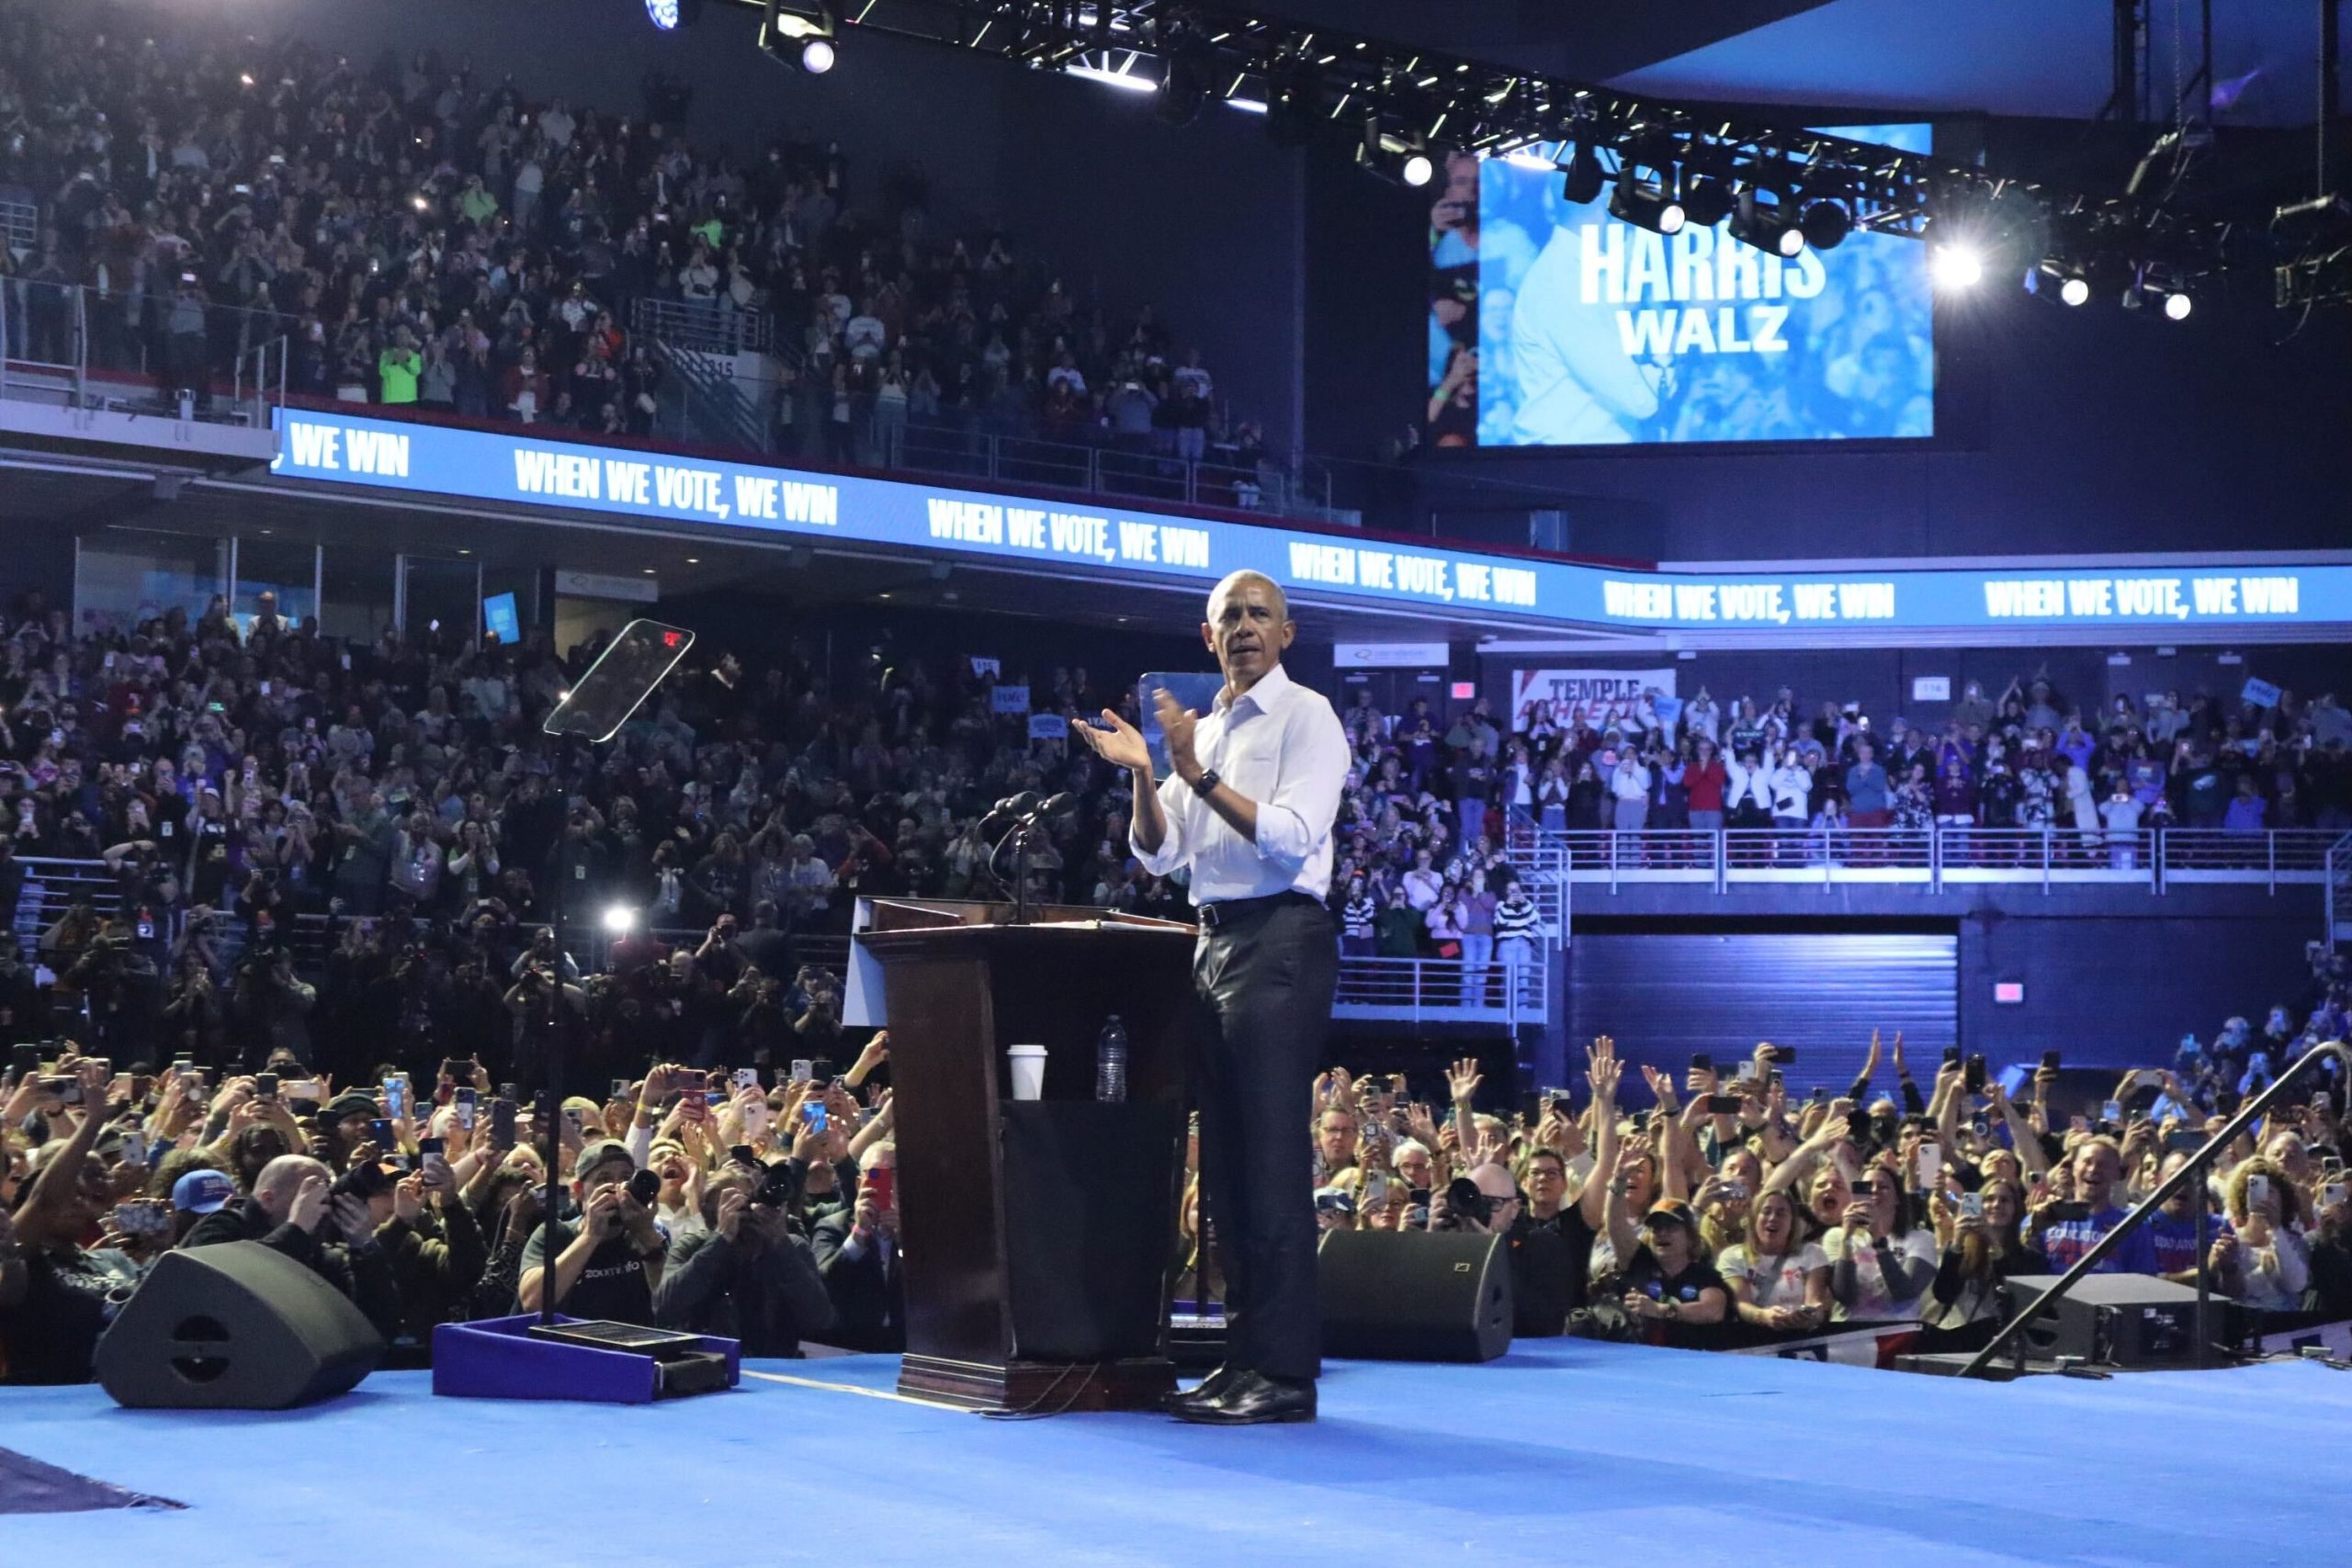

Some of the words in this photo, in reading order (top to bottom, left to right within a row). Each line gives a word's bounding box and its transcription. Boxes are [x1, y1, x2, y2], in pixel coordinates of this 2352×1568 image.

[1580, 221, 1826, 304] HARRIS
[1615, 306, 1789, 355] WALZ
[290, 423, 340, 468] WE
[345, 429, 409, 477] WIN
[514, 449, 600, 499] WHEN
[605, 460, 650, 504] WE
[655, 466, 729, 519] VOTE,
[735, 476, 778, 519] WE
[783, 481, 837, 525] WIN
[928, 499, 1002, 544] WHEN
[1007, 508, 1046, 548] WE
[1050, 513, 1115, 561] VOTE,
[1119, 521, 1158, 561] WE
[1160, 526, 1209, 568] WIN
[1290, 542, 1355, 584] WHEN
[1359, 550, 1393, 589] WE
[1396, 555, 1453, 601] VOTE,
[1456, 563, 1490, 600] WE
[1492, 567, 1536, 605] WIN
[1985, 581, 2064, 616] WHEN
[2069, 580, 2111, 615] WE
[2116, 579, 2189, 619] VOTE,
[2193, 578, 2236, 614] WE
[2241, 578, 2298, 613] WIN
[1604, 581, 1672, 618] WHEN
[1676, 585, 1716, 619] WE
[1719, 585, 1791, 624] VOTE,
[1794, 583, 1836, 618] WE
[1839, 583, 1894, 618] WIN
[1549, 678, 1641, 701] TEMPLE
